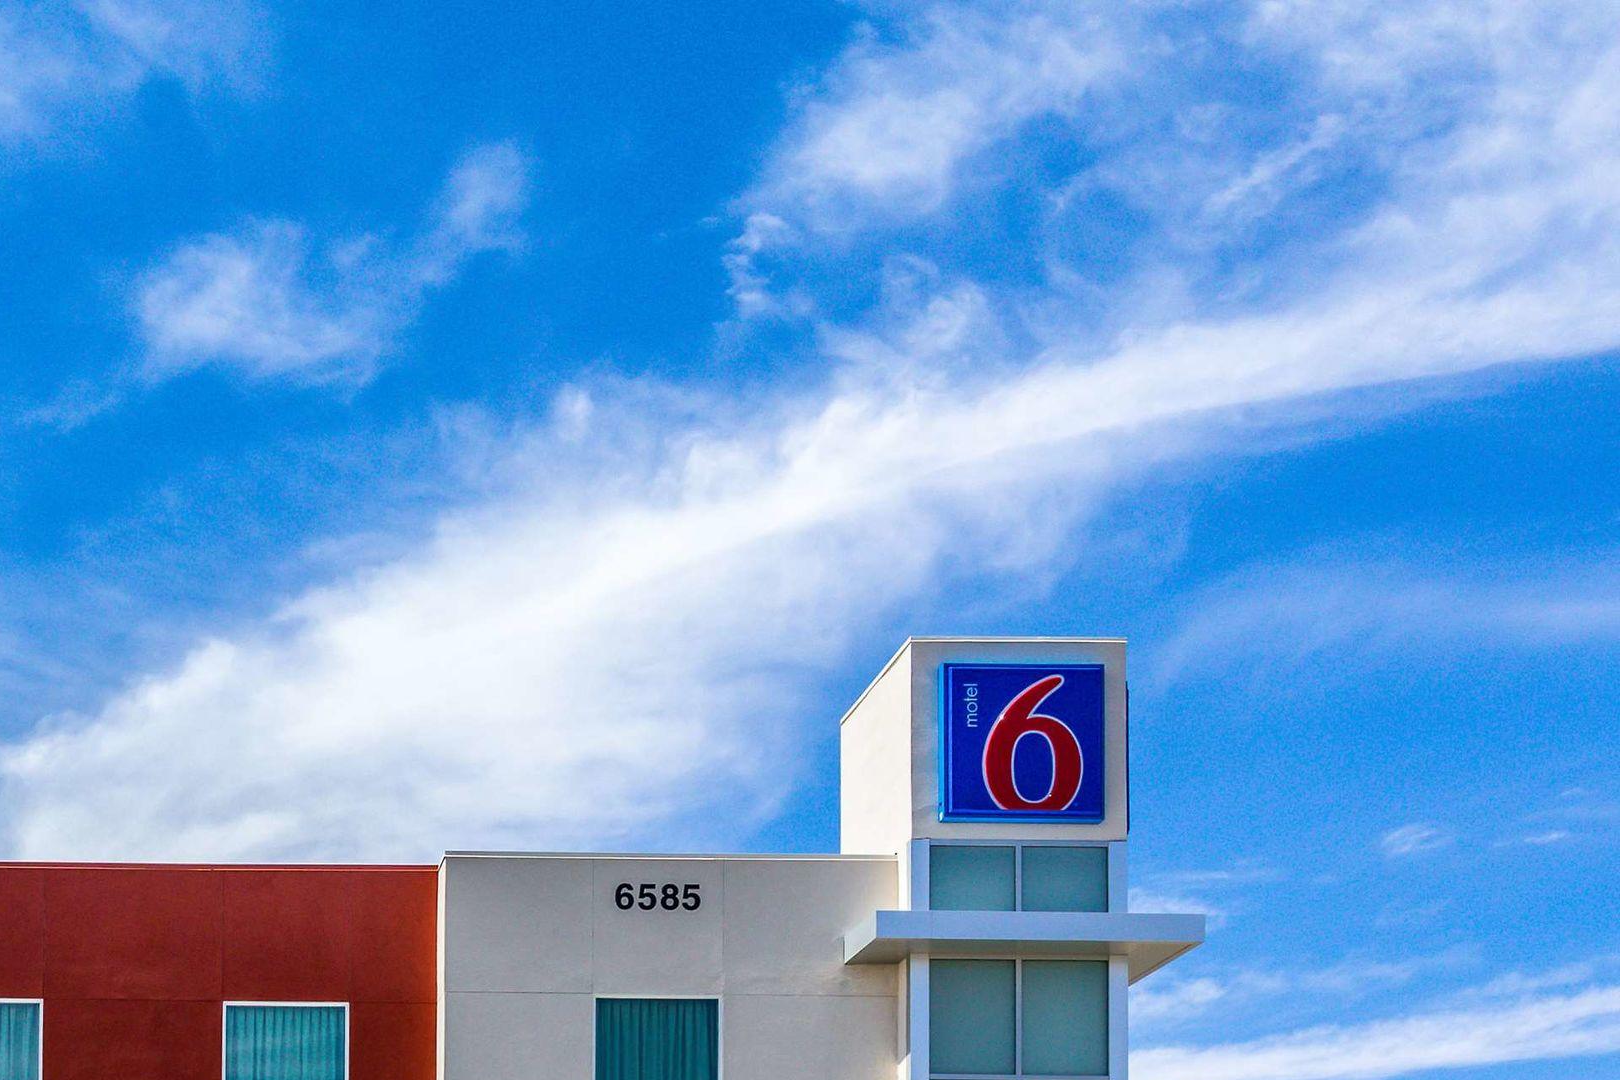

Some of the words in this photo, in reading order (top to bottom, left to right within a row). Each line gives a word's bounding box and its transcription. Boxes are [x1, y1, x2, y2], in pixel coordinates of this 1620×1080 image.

[963, 683, 978, 728] motel
[982, 674, 1084, 811] 6
[615, 883, 701, 911] 6585
